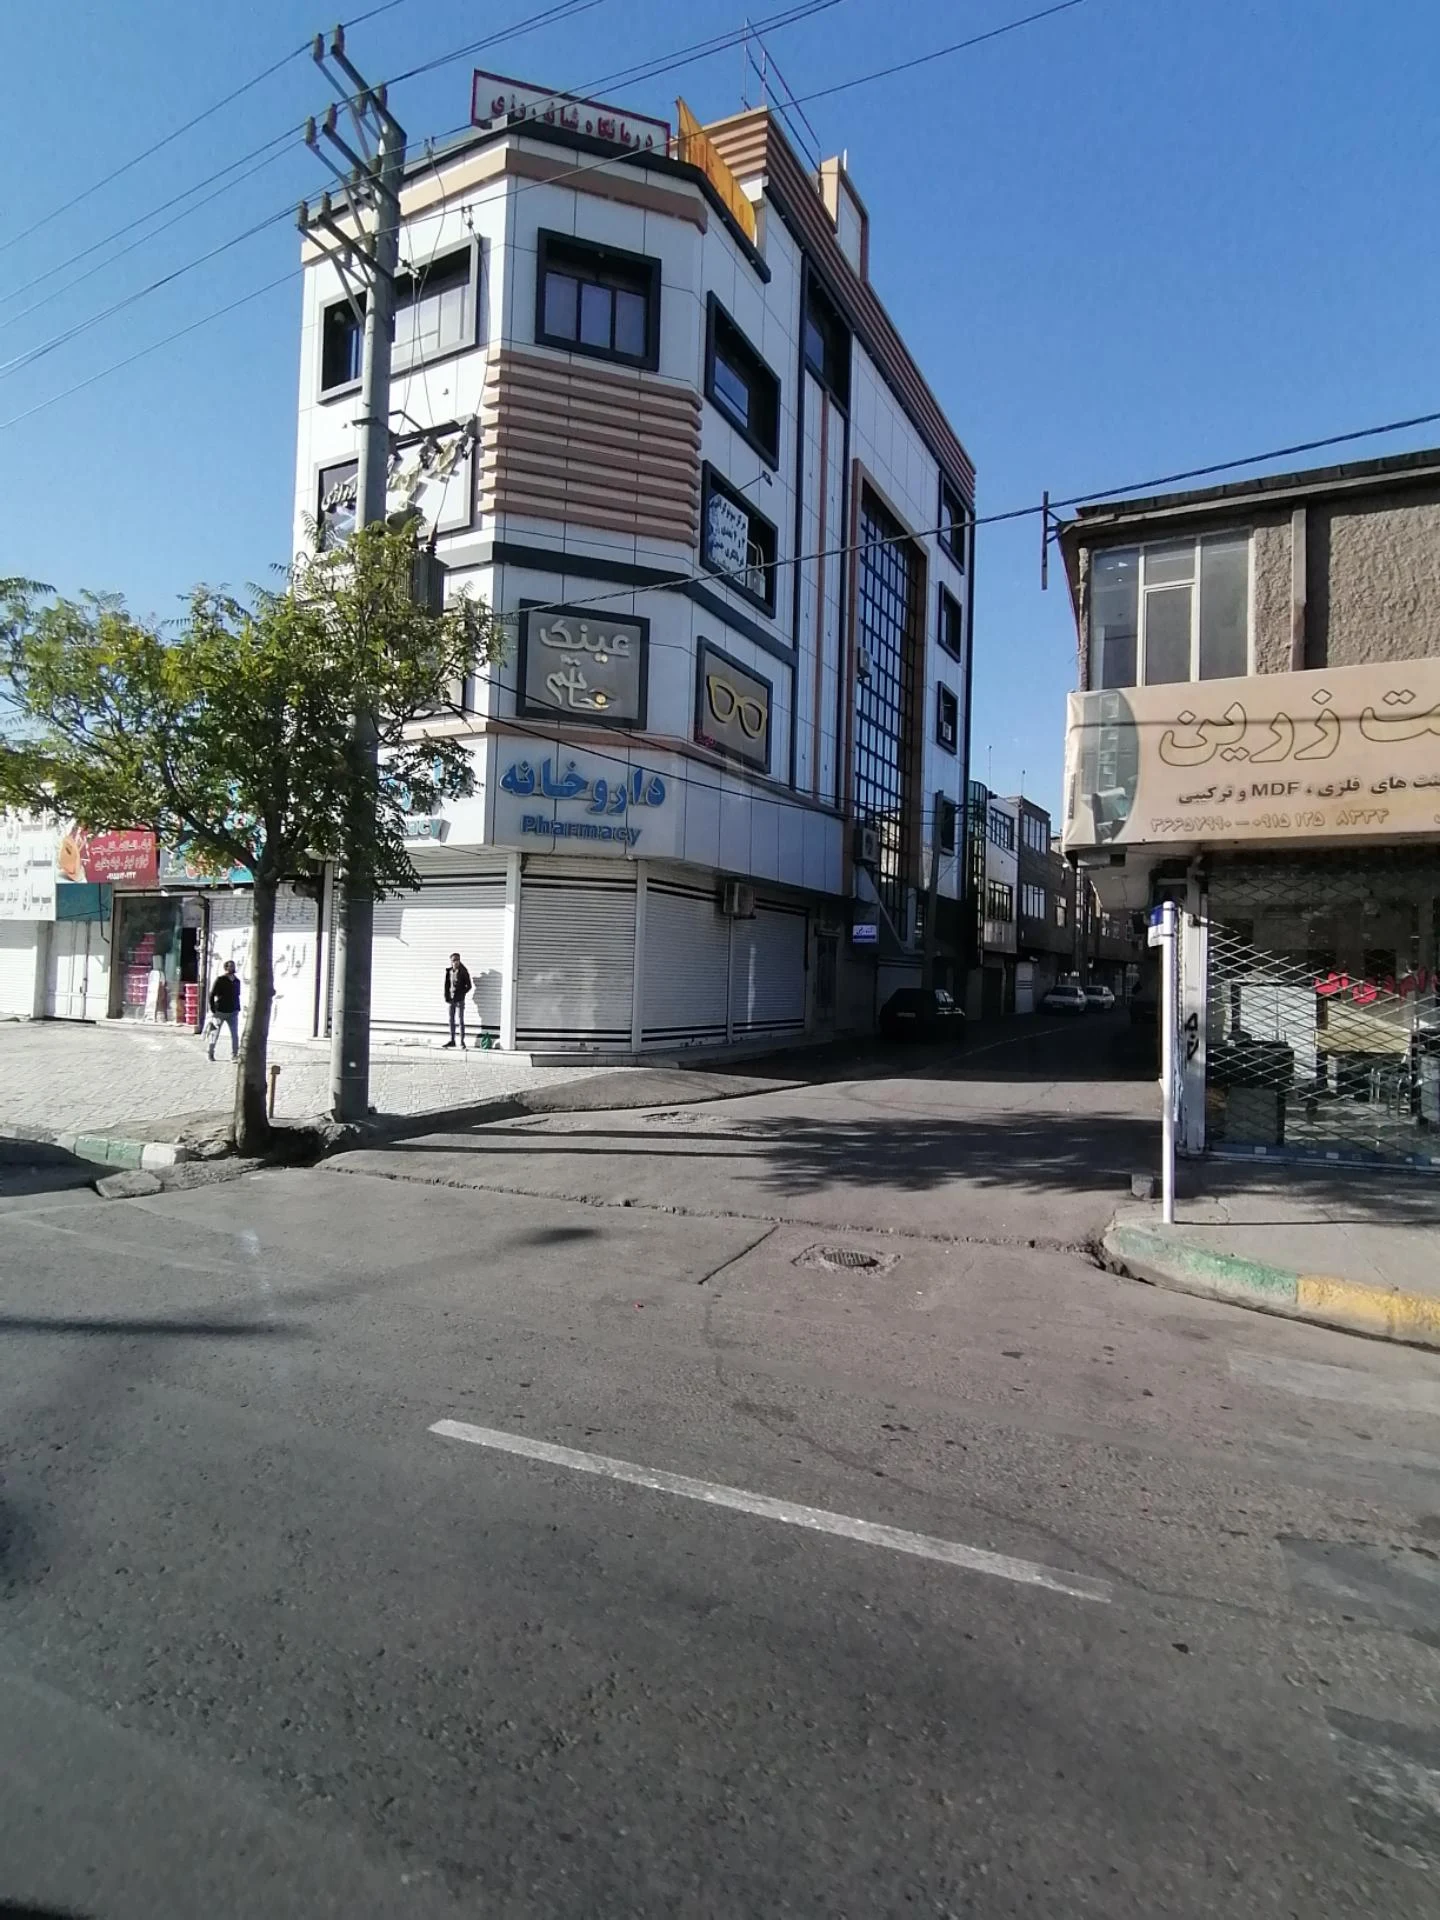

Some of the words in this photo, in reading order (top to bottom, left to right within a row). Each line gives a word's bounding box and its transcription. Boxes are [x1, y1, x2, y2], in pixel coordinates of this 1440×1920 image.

[539, 619, 632, 664] عینک
[1158, 688, 1342, 767] زرین
[499, 757, 667, 816] داروخانه
[1178, 785, 1234, 805] ترکیبی
[1236, 788, 1247, 803] و
[1251, 781, 1300, 797] MDF
[1370, 776, 1407, 795] های
[519, 814, 643, 847] Pharmacy
